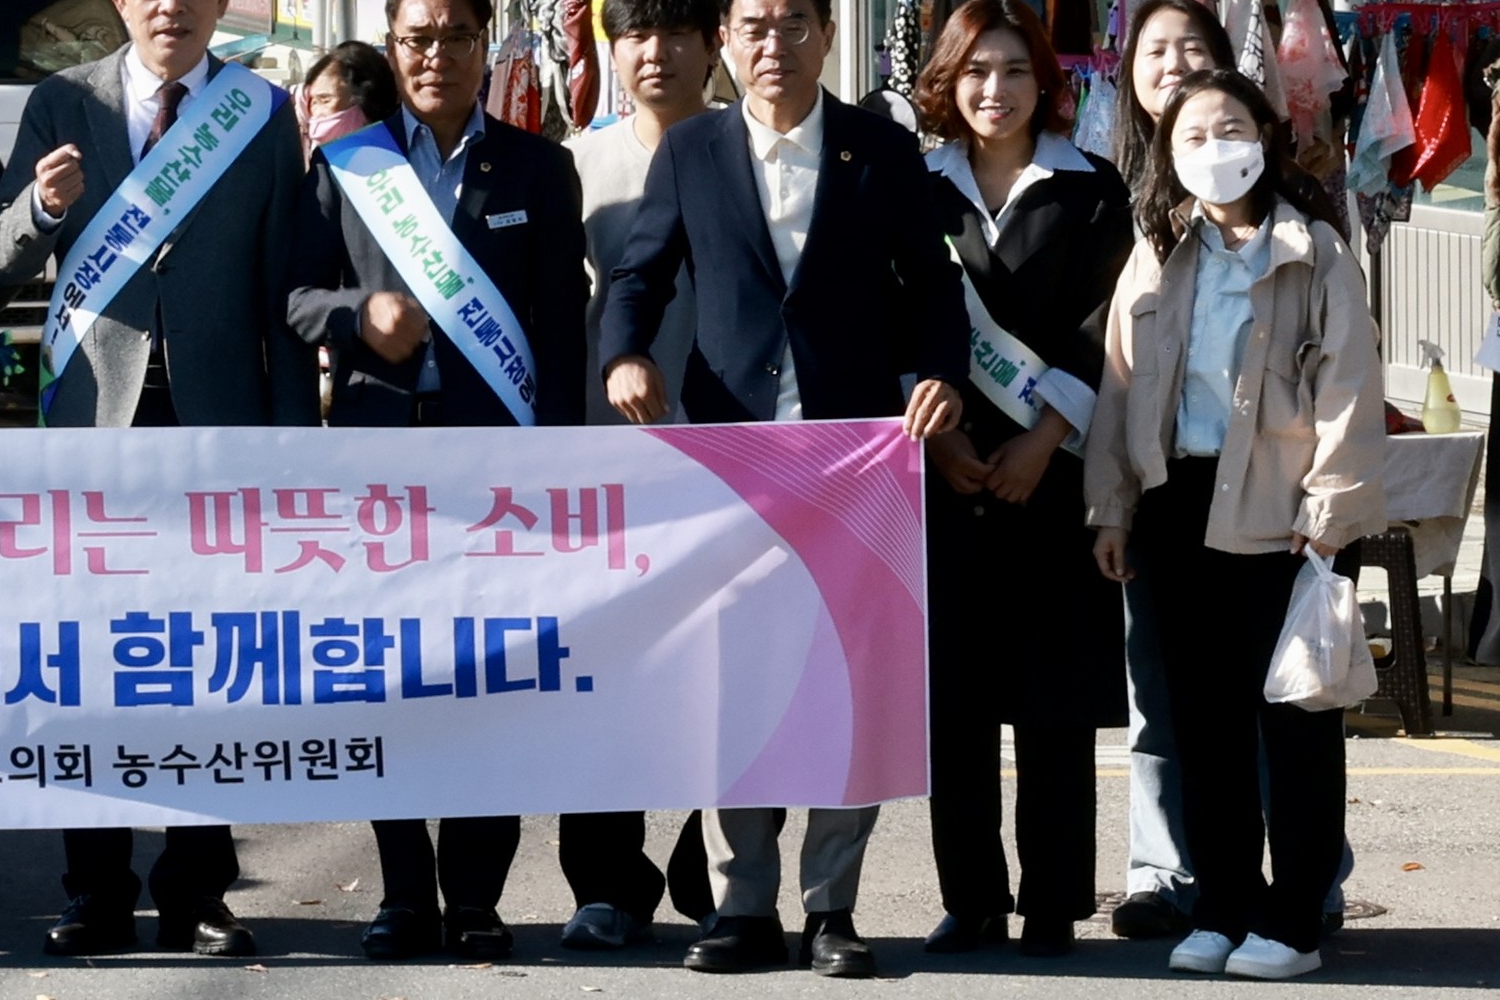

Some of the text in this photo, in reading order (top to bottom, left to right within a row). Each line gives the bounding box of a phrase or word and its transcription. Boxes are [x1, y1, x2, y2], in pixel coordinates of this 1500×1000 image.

[210, 86, 252, 132] 우리
[144, 121, 220, 216] 농수산물,
[51, 203, 152, 345] 전통시장에서!
[366, 168, 405, 216] 우리
[392, 213, 475, 301] 농수산물,
[184, 483, 436, 574] 따뜻한
[464, 483, 651, 578] 소비,
[110, 610, 594, 707] 함께합니다.
[112, 736, 386, 788] 농수산위원회
